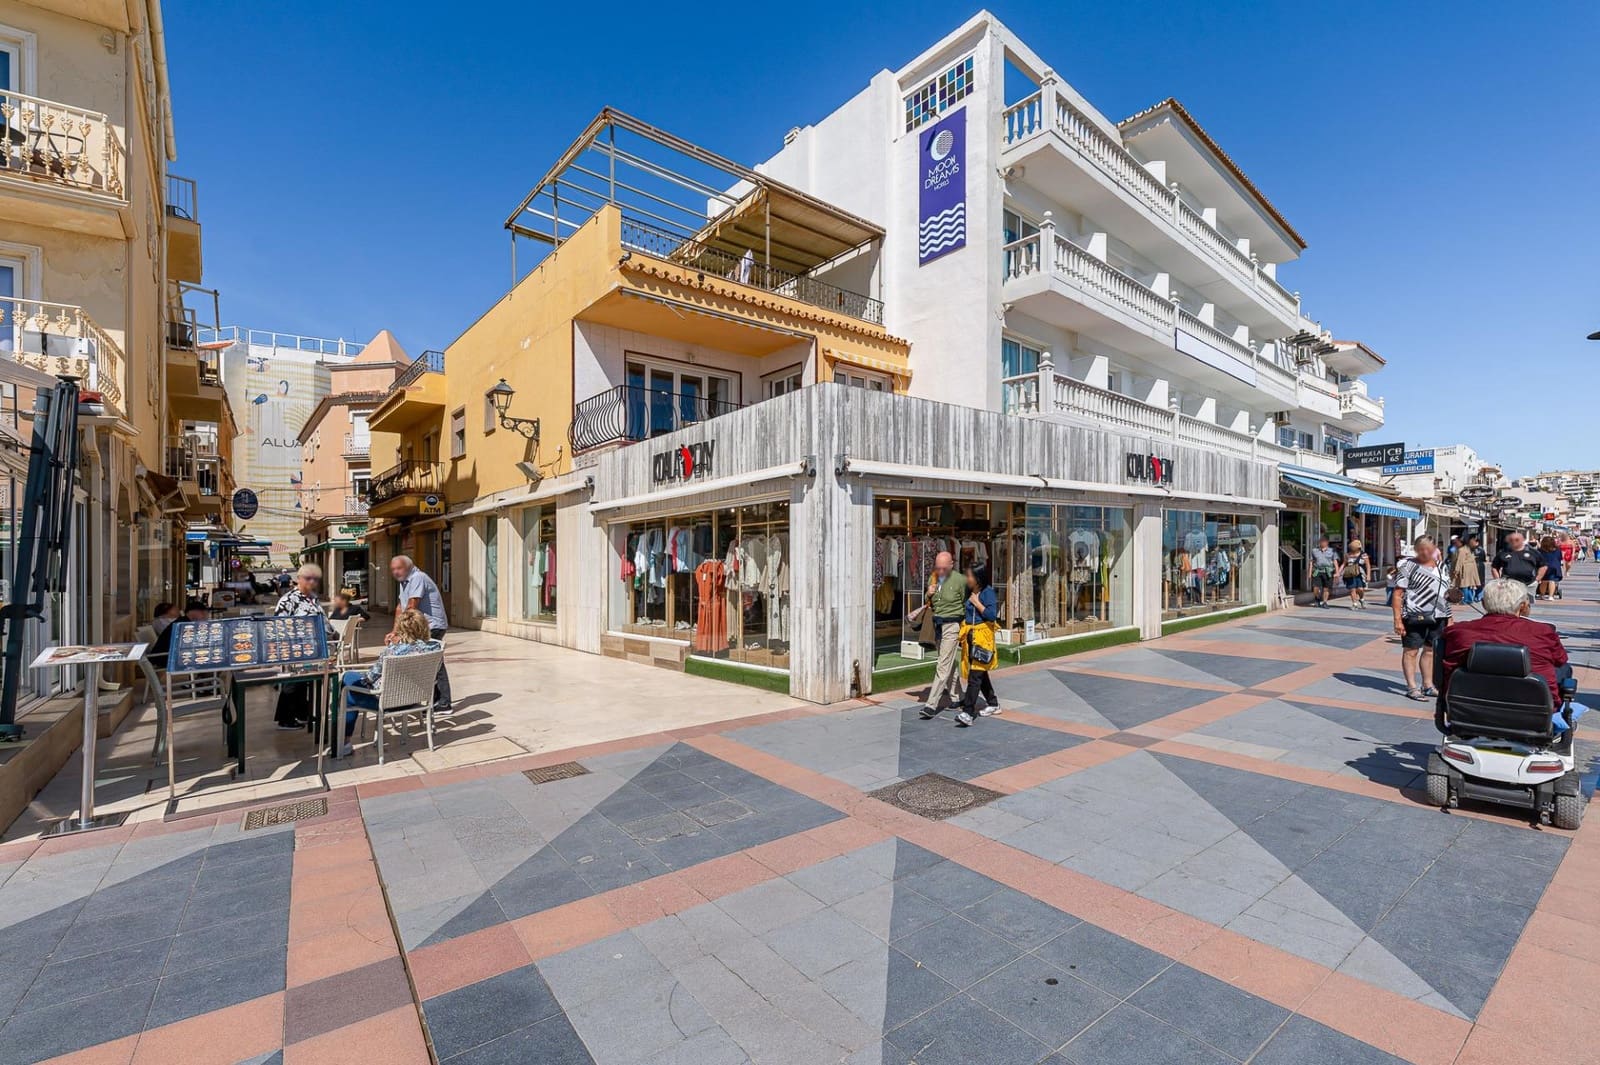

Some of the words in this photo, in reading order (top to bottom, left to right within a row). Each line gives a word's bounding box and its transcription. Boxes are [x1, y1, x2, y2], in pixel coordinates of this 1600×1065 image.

[929, 154, 956, 178] MOON
[924, 163, 960, 189] DREAMS
[1347, 449, 1382, 458] CARIHUELA
[1387, 447, 1403, 456] CB
[1404, 451, 1433, 459] URANTE
[1390, 455, 1400, 463] 65
